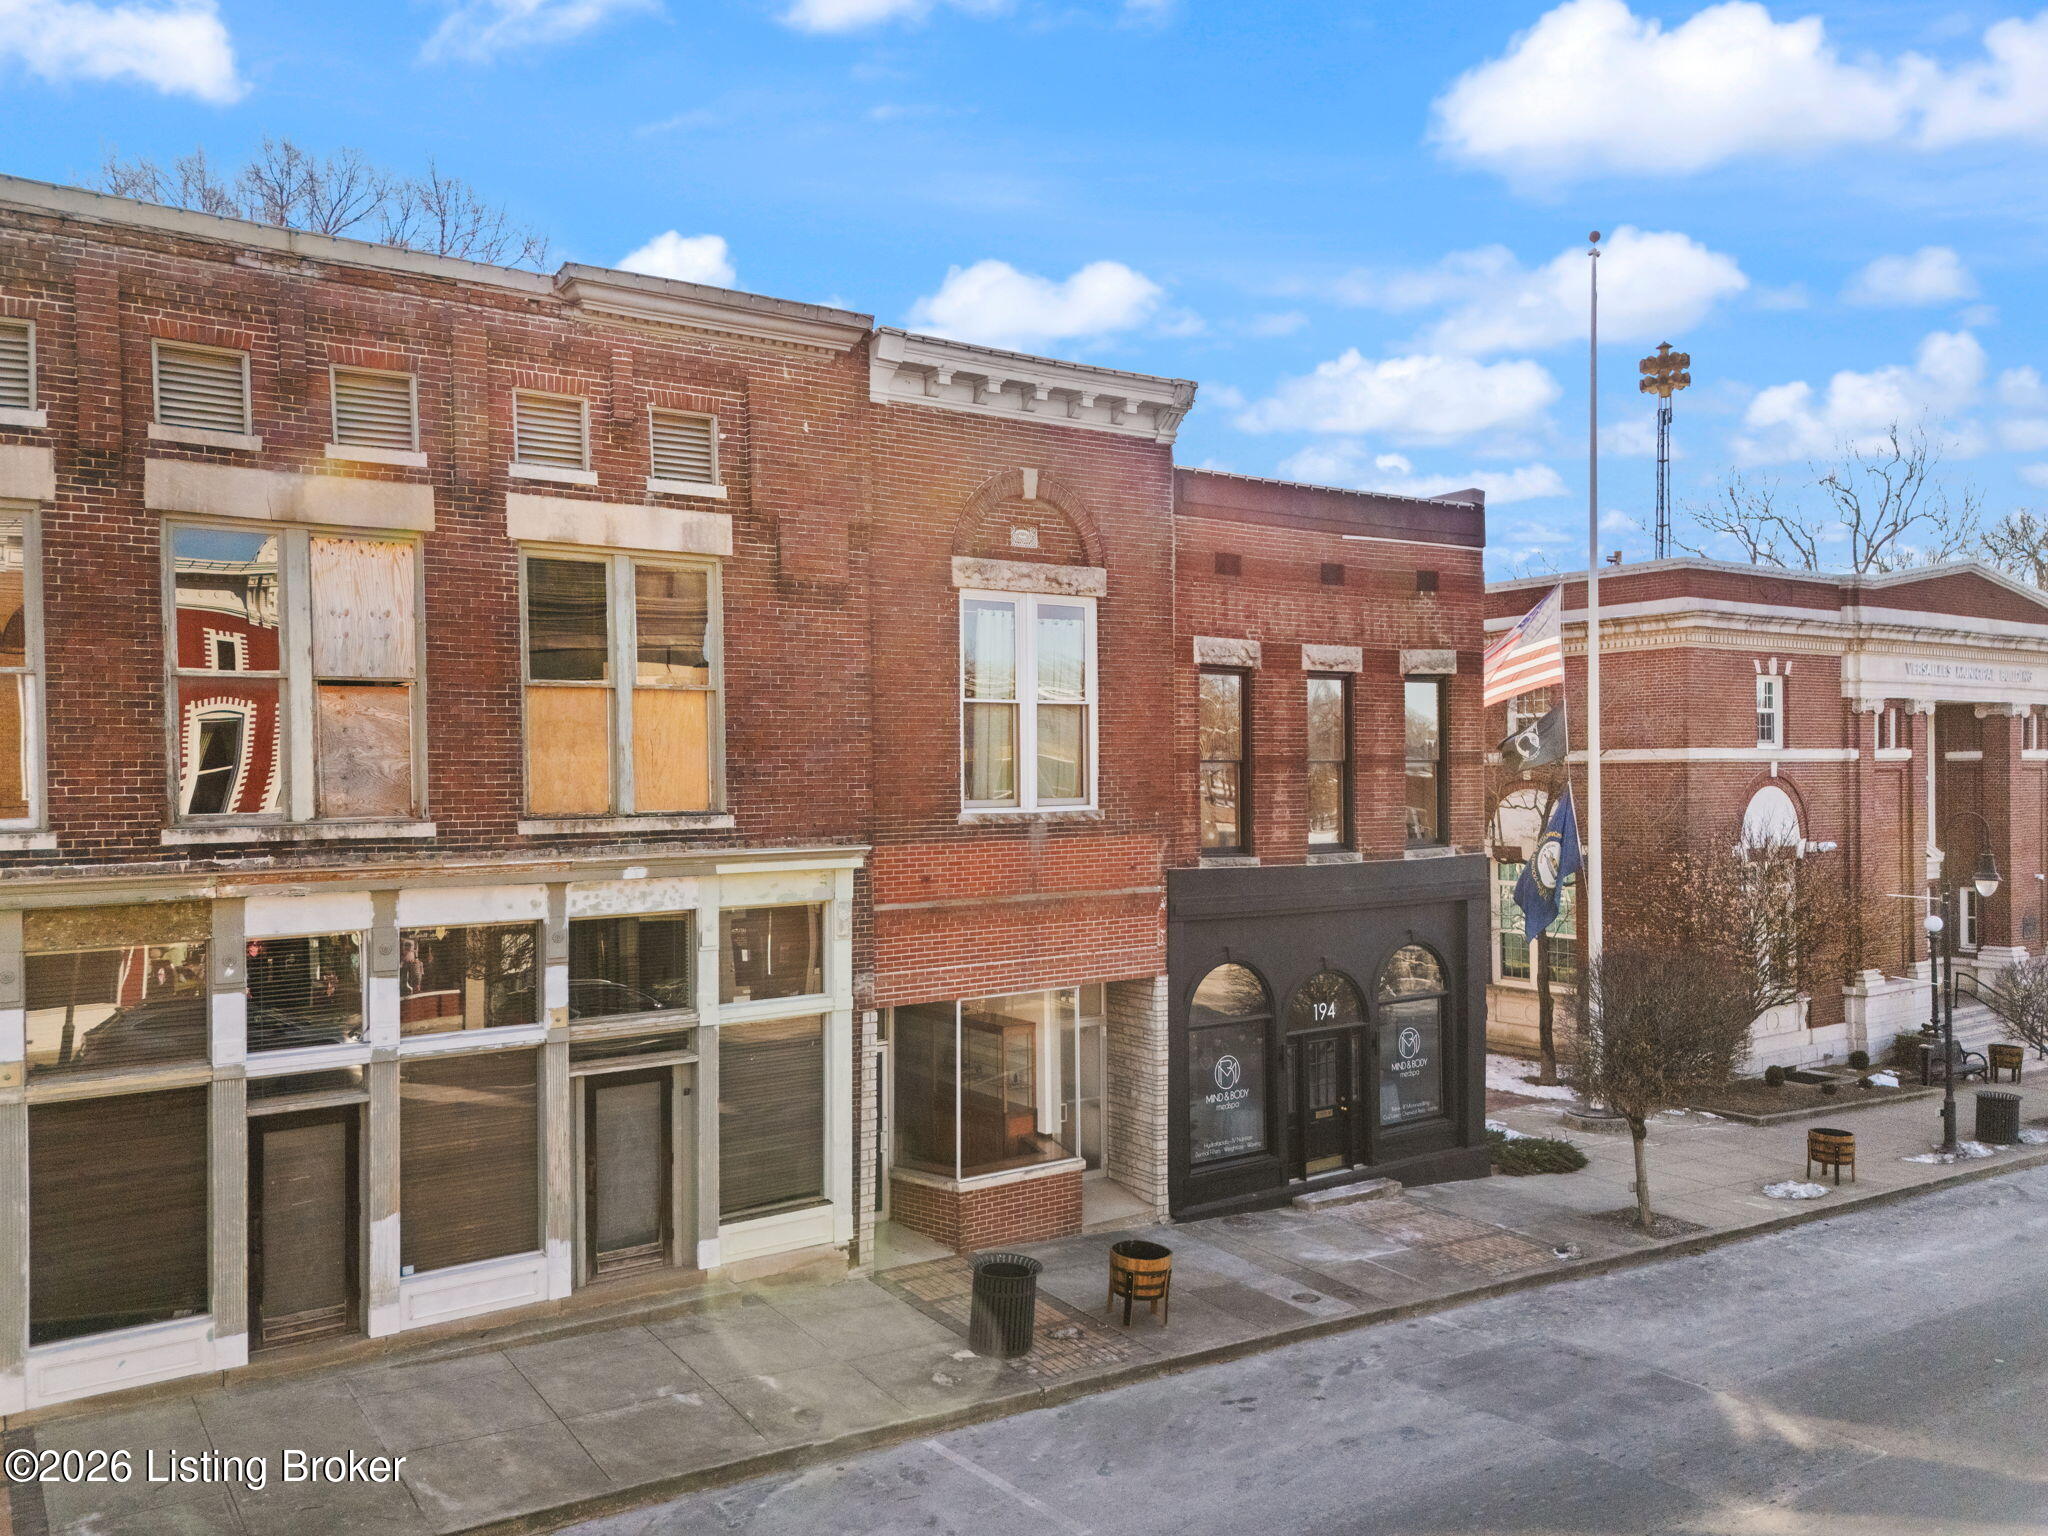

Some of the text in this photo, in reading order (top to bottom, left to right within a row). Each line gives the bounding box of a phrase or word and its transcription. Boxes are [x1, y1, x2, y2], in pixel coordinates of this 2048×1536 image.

[1313, 1001, 1336, 1021] 194
[1391, 1058, 1428, 1071] MIND & BODY
[1205, 1088, 1249, 1104] MIND & BODY
[1216, 1101, 1239, 1111] medspa
